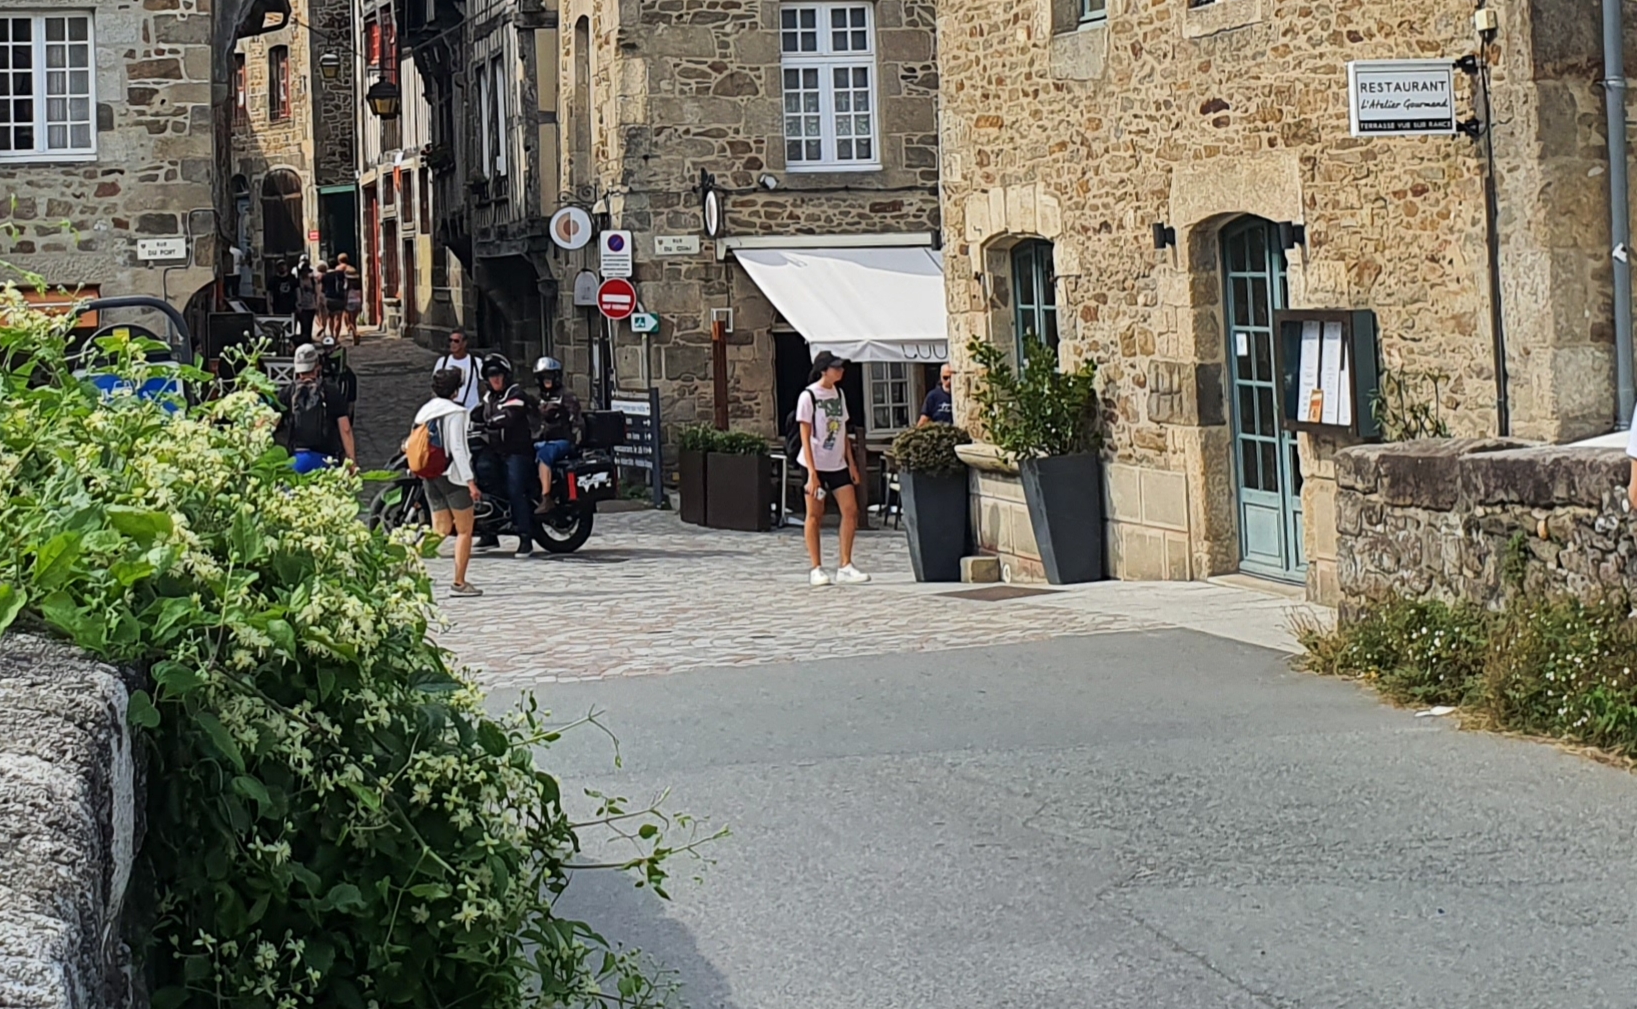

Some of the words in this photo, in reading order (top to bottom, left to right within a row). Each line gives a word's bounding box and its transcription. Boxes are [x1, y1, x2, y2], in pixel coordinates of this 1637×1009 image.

[1360, 81, 1447, 93] RESTAURANT
[1361, 98, 1401, 109] L'Atelier
[1360, 122, 1395, 130] TERRASSE
[1397, 121, 1411, 129] VUE
[1429, 120, 1451, 128] RANCE
